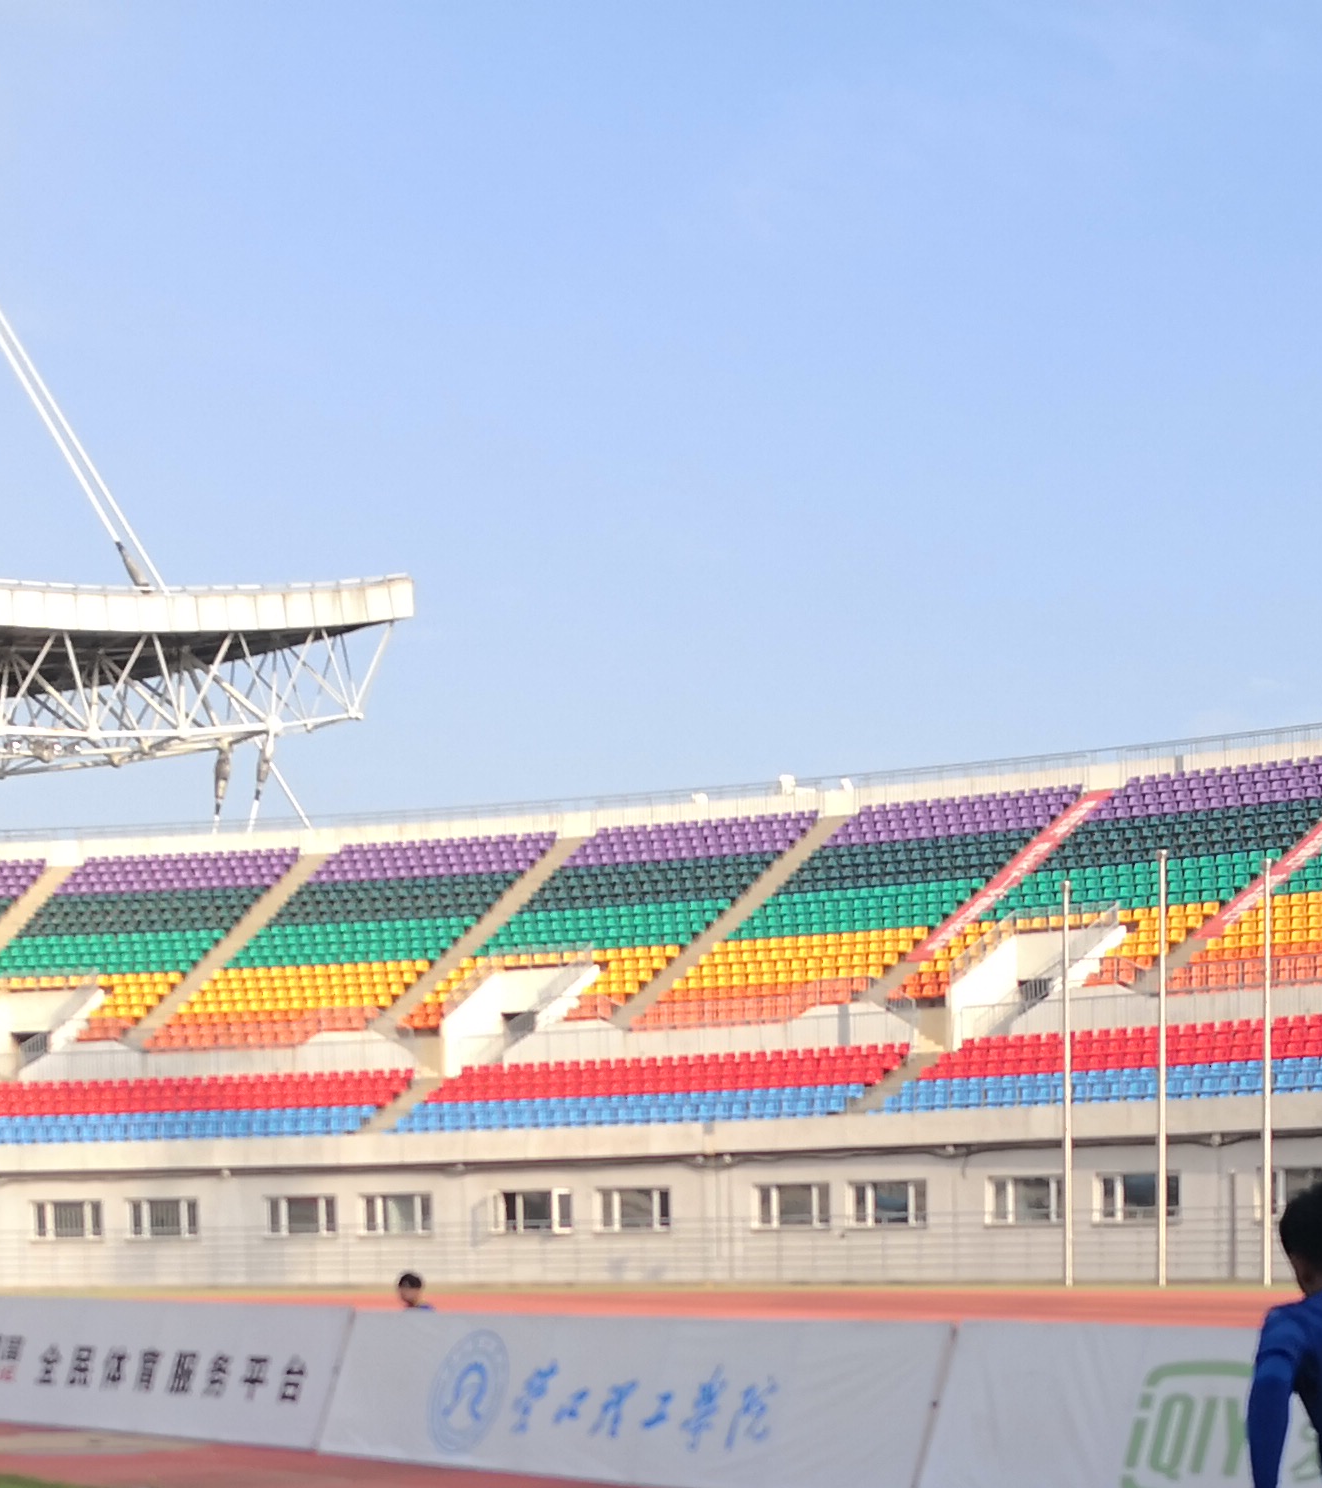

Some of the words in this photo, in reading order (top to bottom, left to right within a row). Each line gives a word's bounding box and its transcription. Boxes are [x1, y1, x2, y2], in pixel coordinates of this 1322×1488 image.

[33, 1344, 308, 1402] 全民体育服务平台
[1125, 1391, 1250, 1483] iQIY
